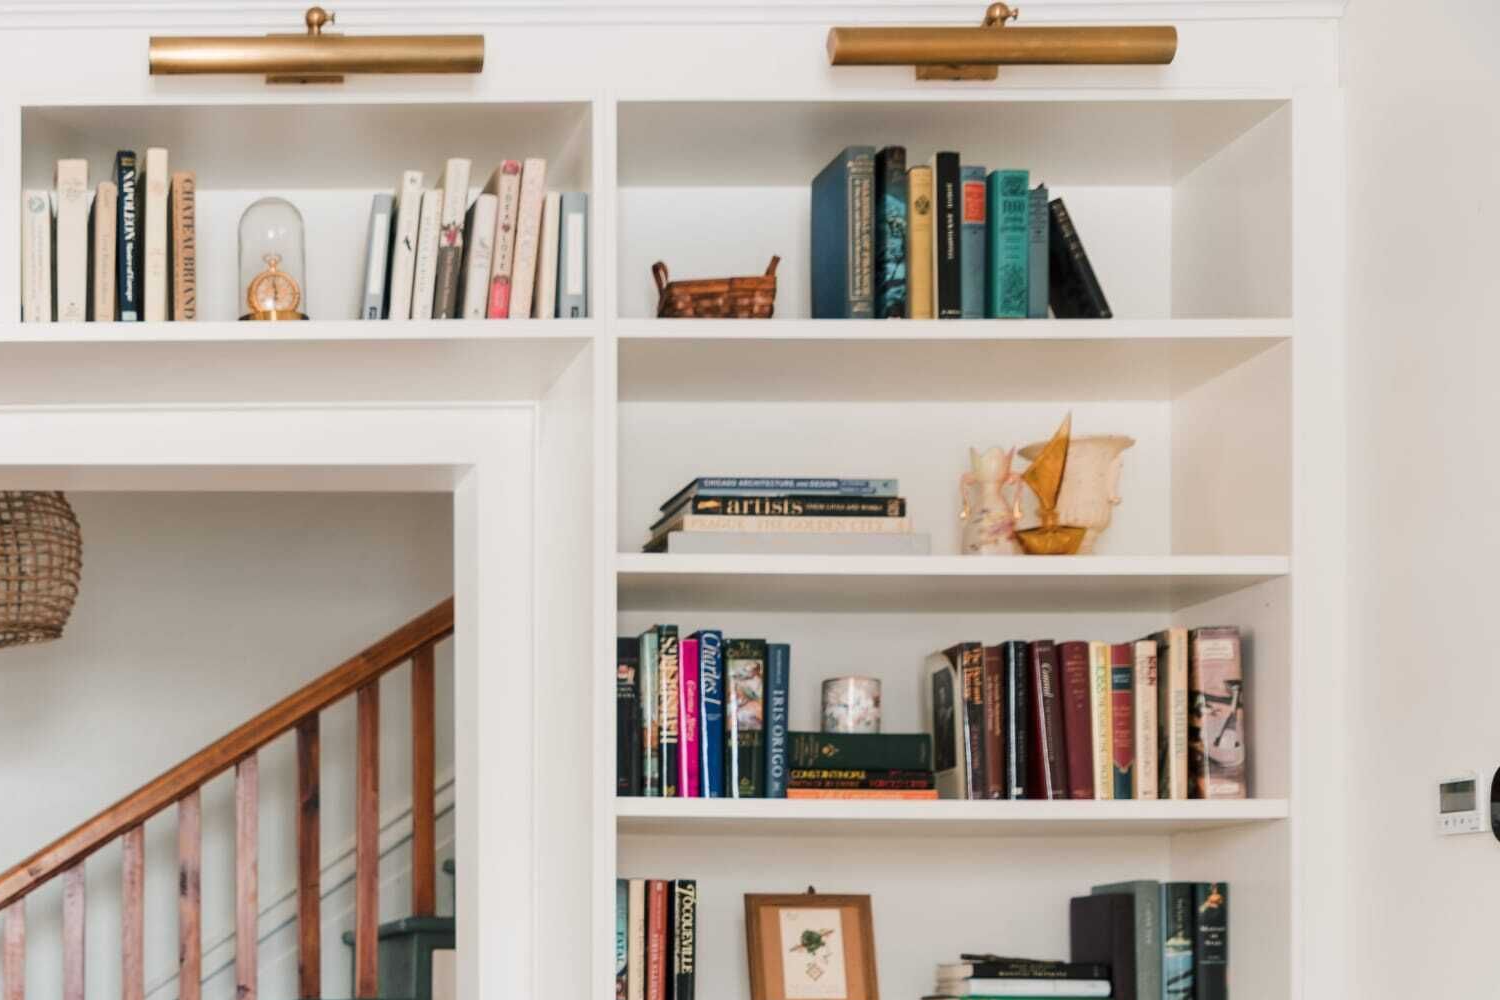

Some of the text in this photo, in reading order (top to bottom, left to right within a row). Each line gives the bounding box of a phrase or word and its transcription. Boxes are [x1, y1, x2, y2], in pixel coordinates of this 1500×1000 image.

[122, 170, 136, 241] NAPOLEON
[181, 177, 196, 320] CHATEAUBRIAND
[703, 479, 737, 489] CHICAGO
[738, 479, 794, 489] ARCHITECTURE
[809, 479, 838, 489] DESIGN
[726, 499, 803, 515] artists
[701, 632, 722, 694] Charles
[772, 689, 784, 721] IRIS
[771, 724, 784, 777] ORIGO
[675, 884, 695, 974] TOCQUEVILLE
